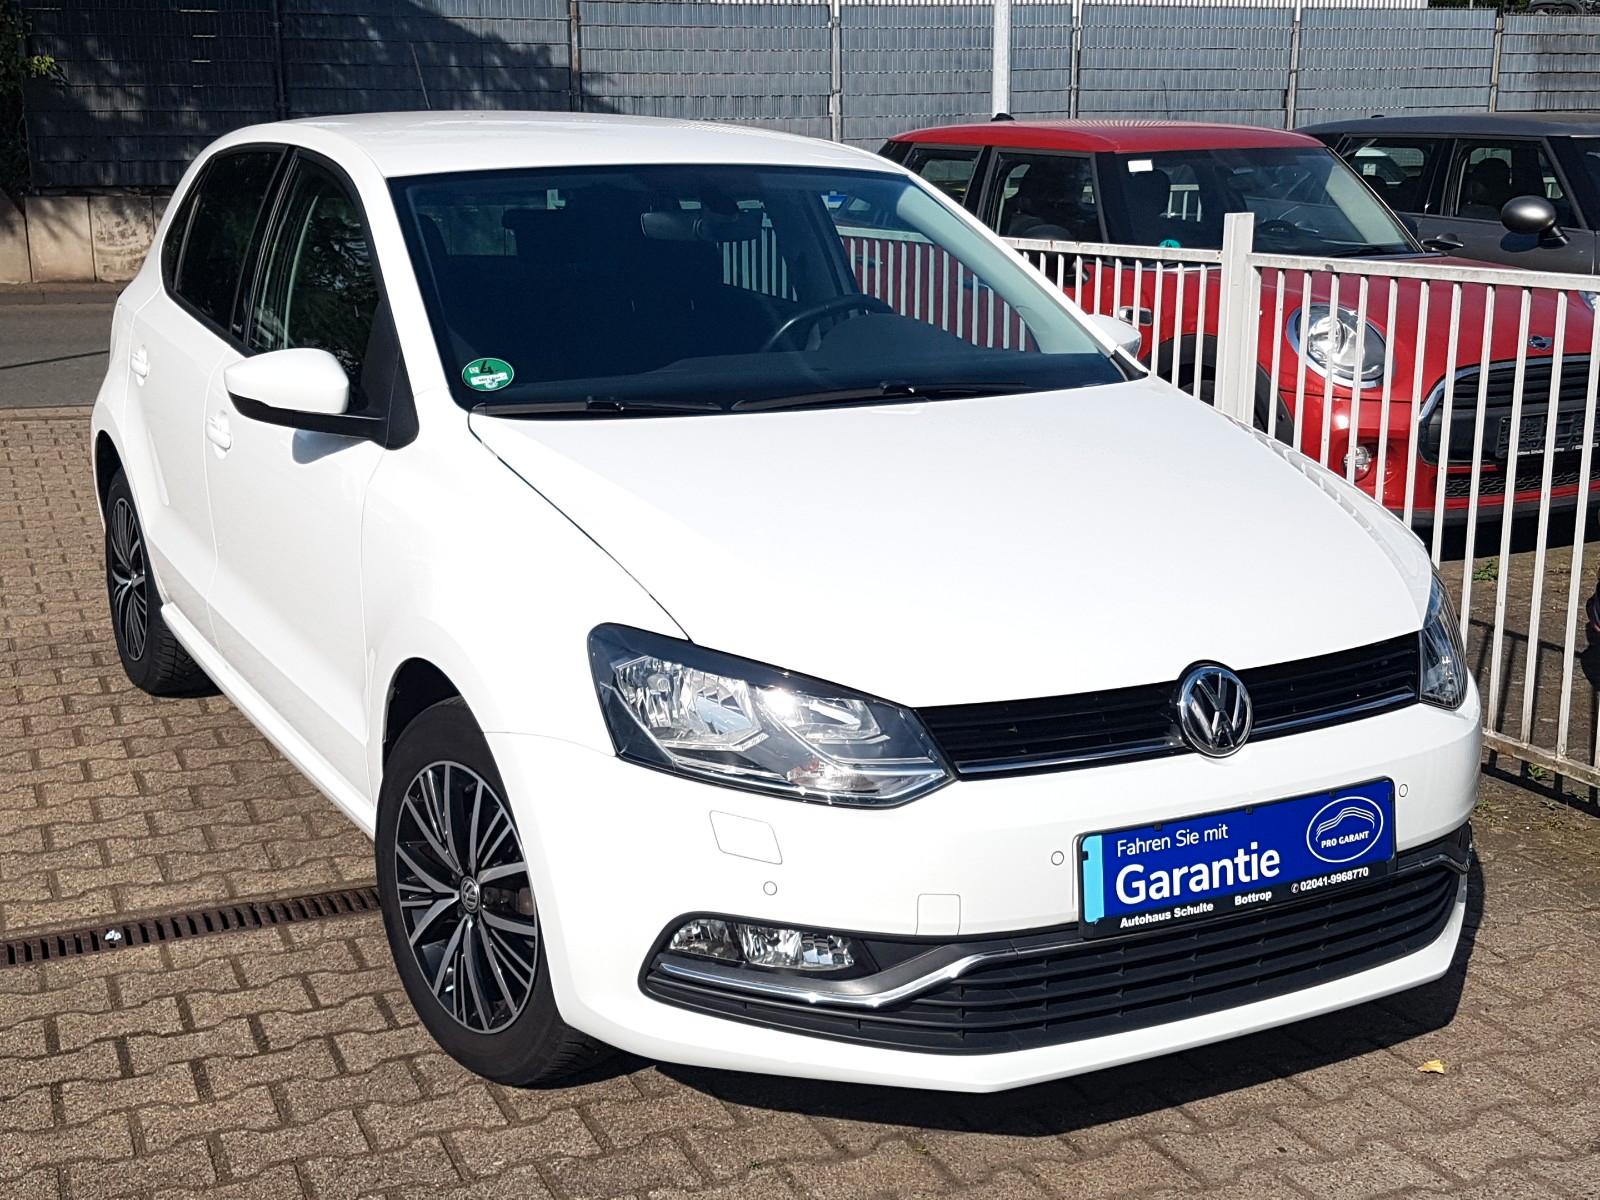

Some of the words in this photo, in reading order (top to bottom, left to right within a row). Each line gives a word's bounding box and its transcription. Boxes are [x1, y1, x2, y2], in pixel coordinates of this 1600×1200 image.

[1183, 667, 1248, 755] VW
[1117, 836, 1171, 857] Fahren
[1175, 829, 1200, 847] Sie
[1204, 824, 1229, 842] mit
[1321, 838, 1337, 849] PRO
[1338, 830, 1370, 845] GARANT
[1115, 841, 1280, 905] Garantie
[1120, 911, 1171, 928] Autohaus
[1174, 902, 1214, 918] Schulte
[1234, 890, 1272, 906] Bottrop
[1300, 867, 1369, 891] 02041-9968770
